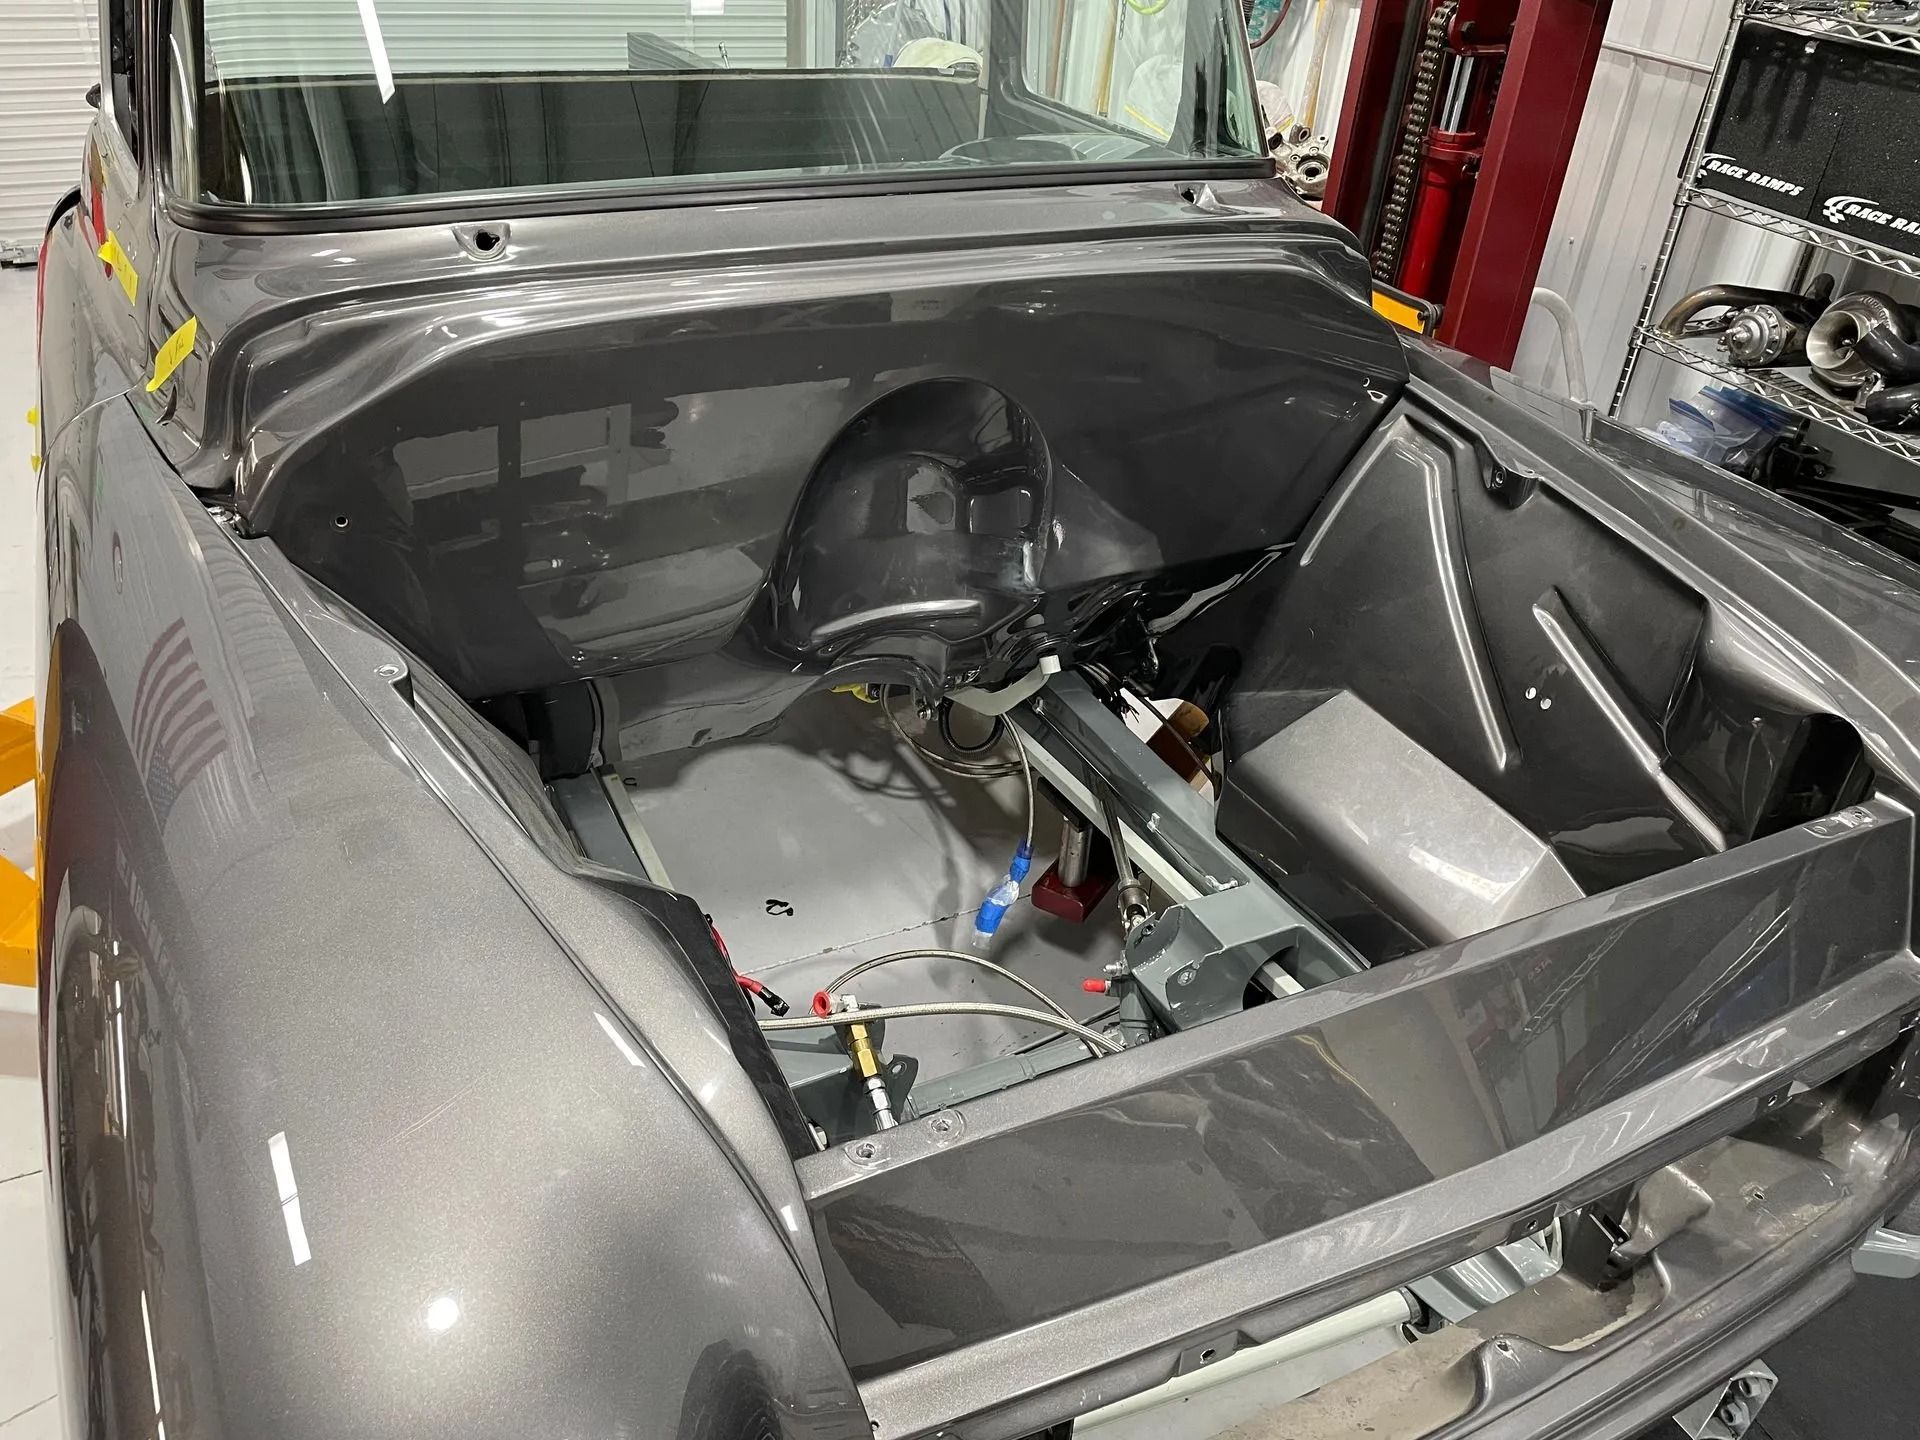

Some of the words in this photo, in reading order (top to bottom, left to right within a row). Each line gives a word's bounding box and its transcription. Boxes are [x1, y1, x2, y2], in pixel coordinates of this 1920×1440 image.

[1706, 160, 1748, 179] RACE
[1745, 172, 1804, 196] RAMPS
[1844, 204, 1893, 225] RACE
